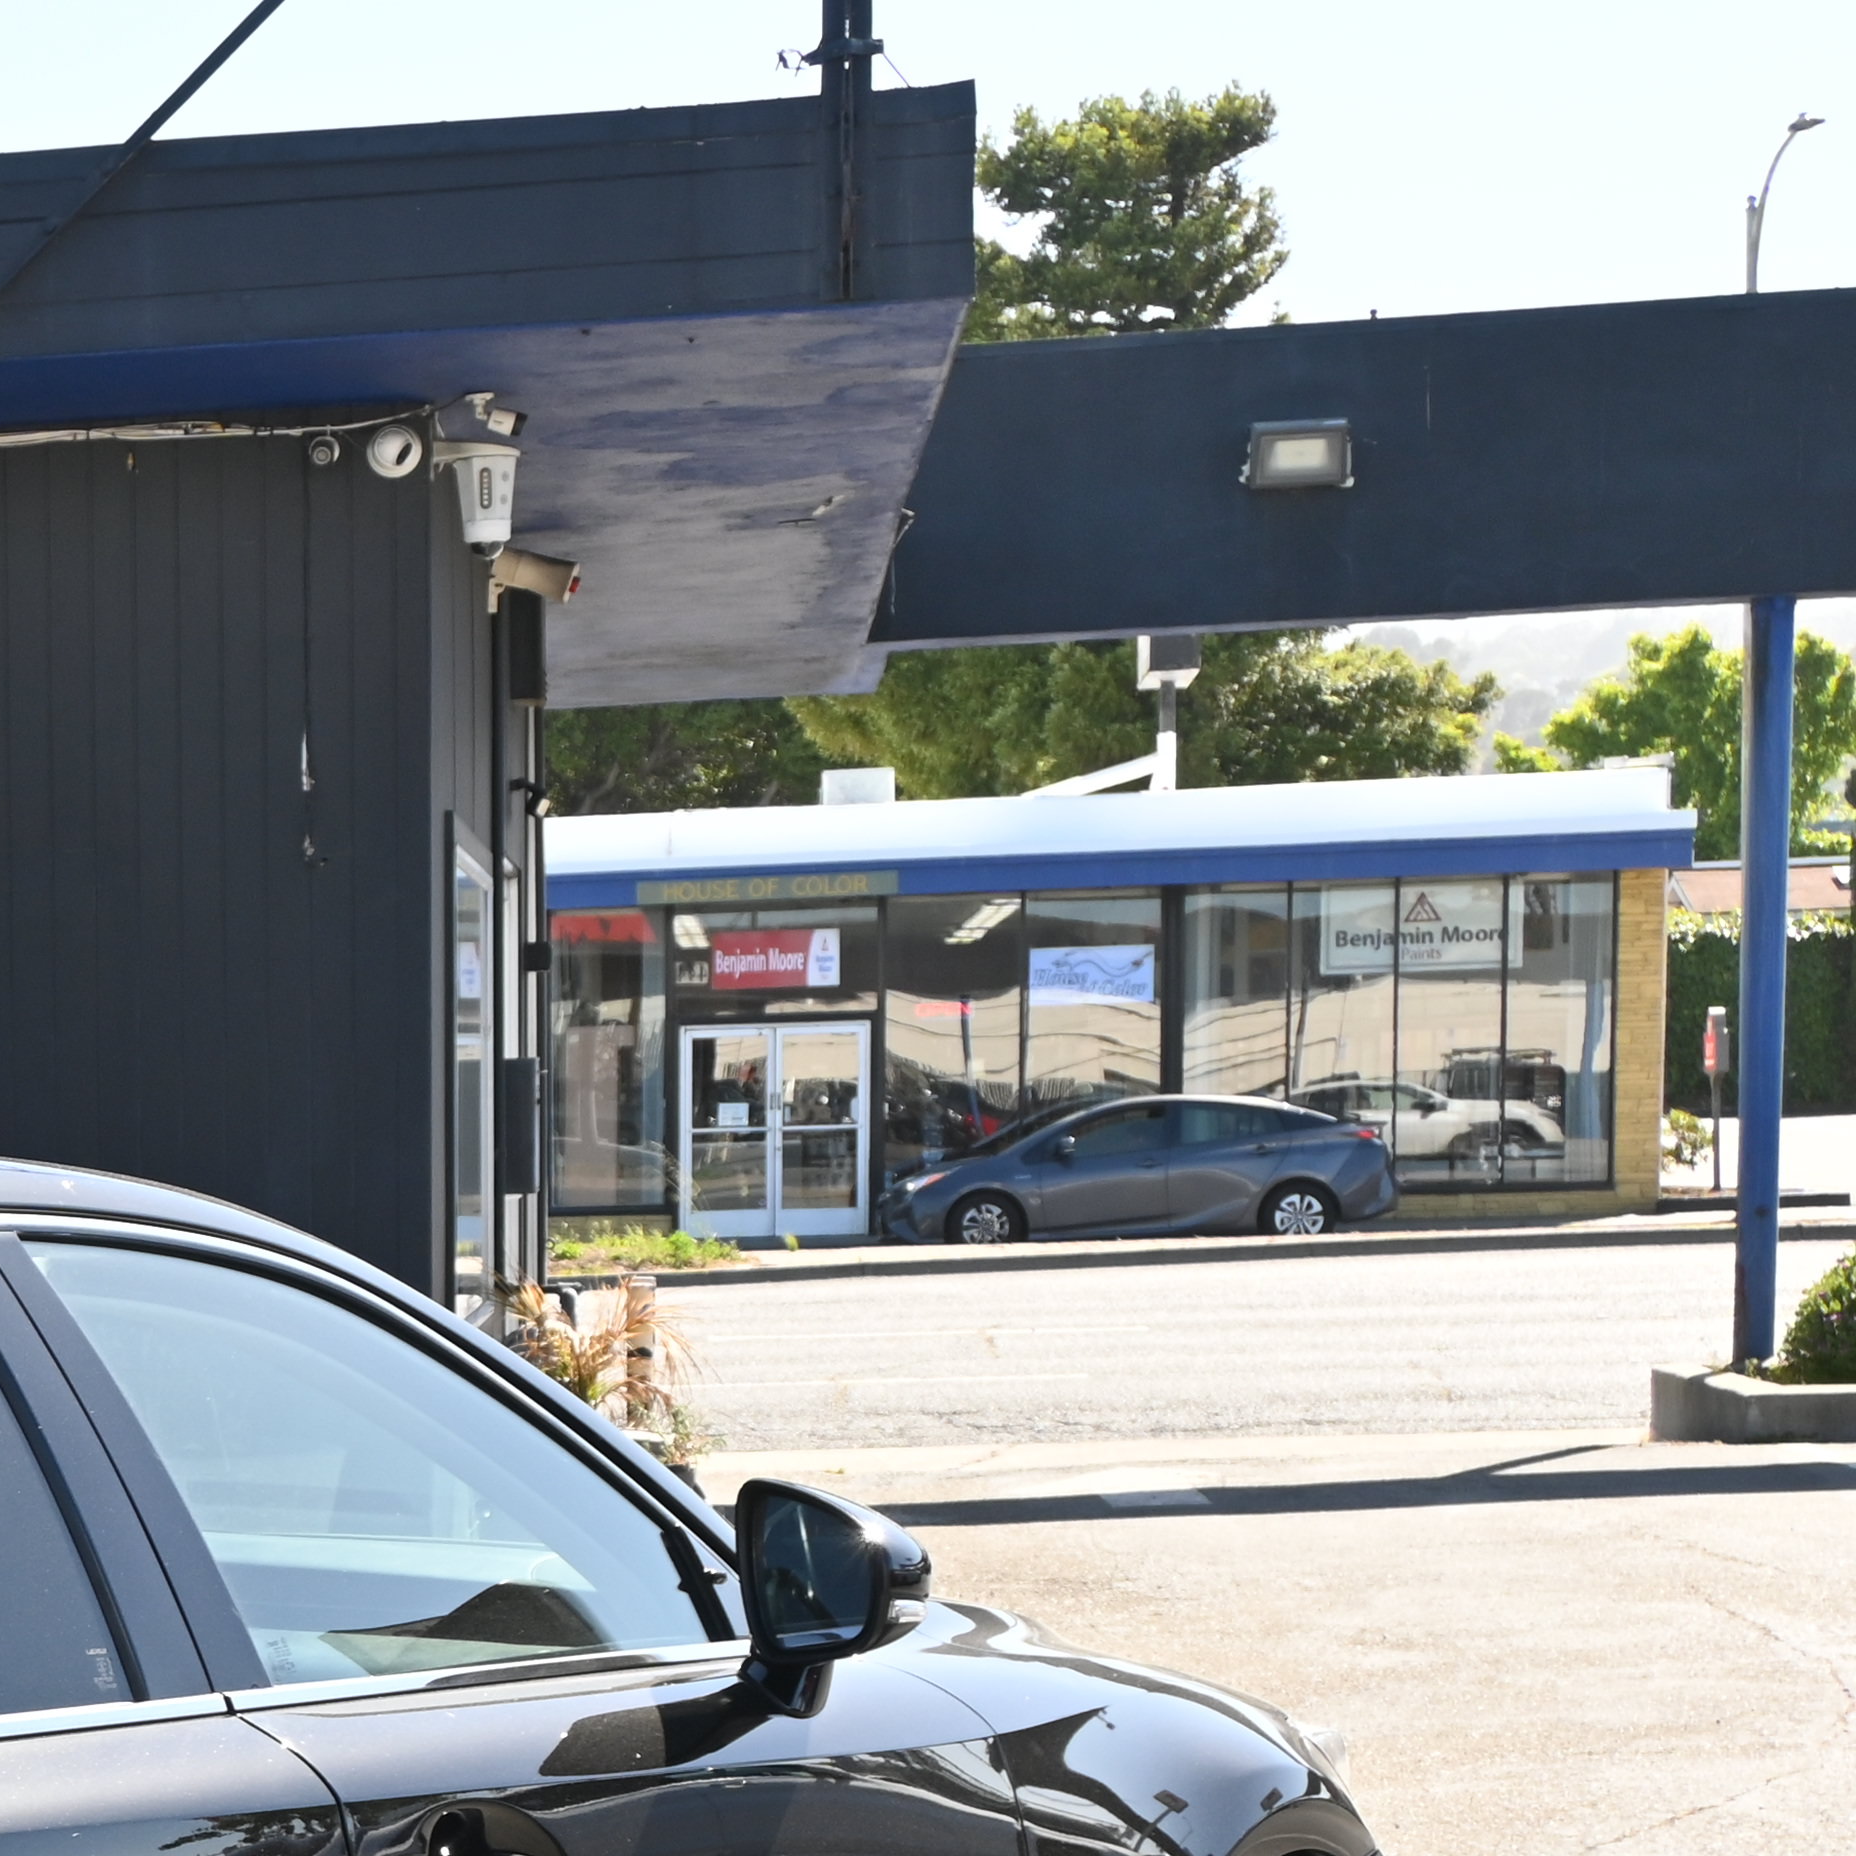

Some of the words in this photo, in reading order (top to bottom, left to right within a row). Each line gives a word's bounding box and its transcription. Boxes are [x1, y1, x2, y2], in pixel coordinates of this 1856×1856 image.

[662, 879, 740, 901] HOUSE
[748, 878, 779, 897] OF
[791, 874, 870, 896] COLOR
[715, 947, 767, 980] Benjamin
[768, 949, 805, 972] Moore
[1400, 947, 1442, 960] Paints
[1031, 968, 1089, 988] House
